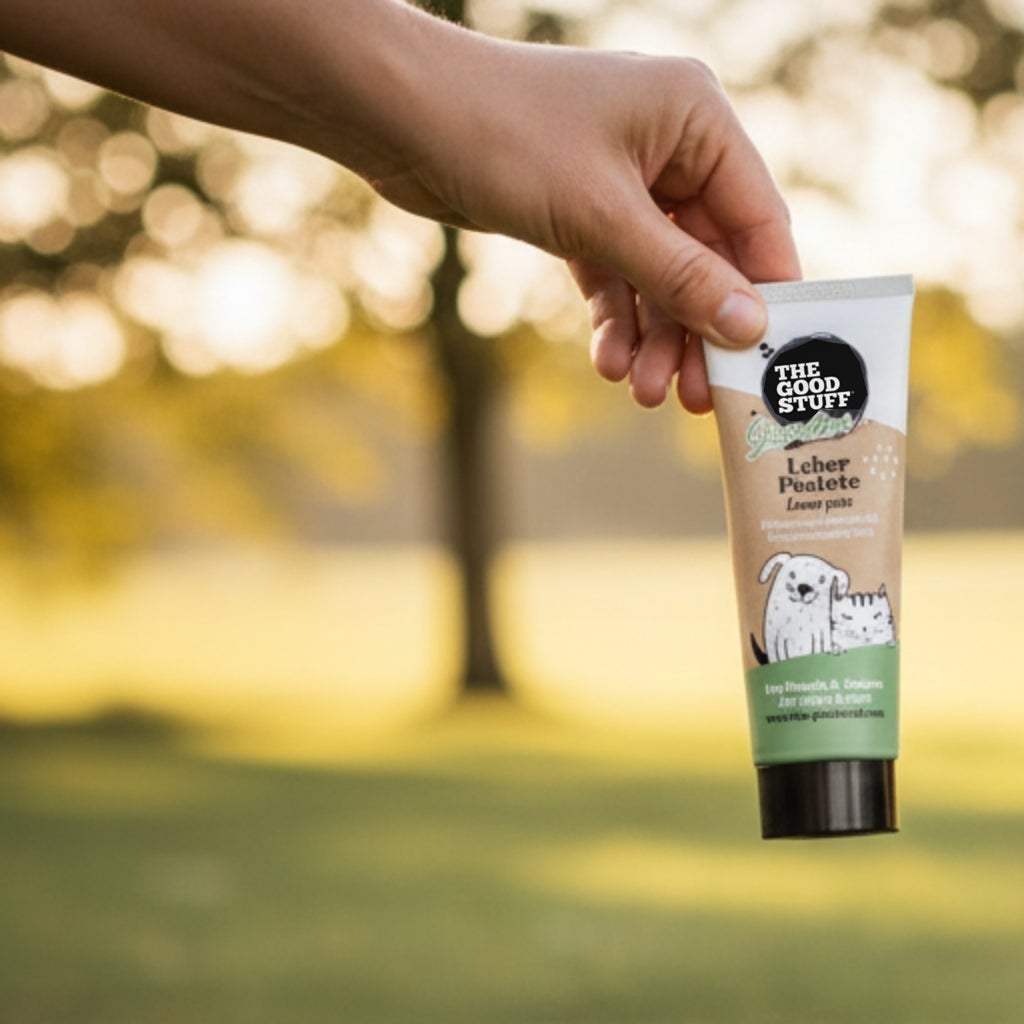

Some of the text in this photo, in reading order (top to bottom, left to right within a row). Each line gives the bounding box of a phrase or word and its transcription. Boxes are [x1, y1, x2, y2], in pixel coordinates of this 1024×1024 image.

[774, 362, 821, 380] THE
[776, 377, 840, 396] GOOD
[778, 391, 851, 413] STUFF
